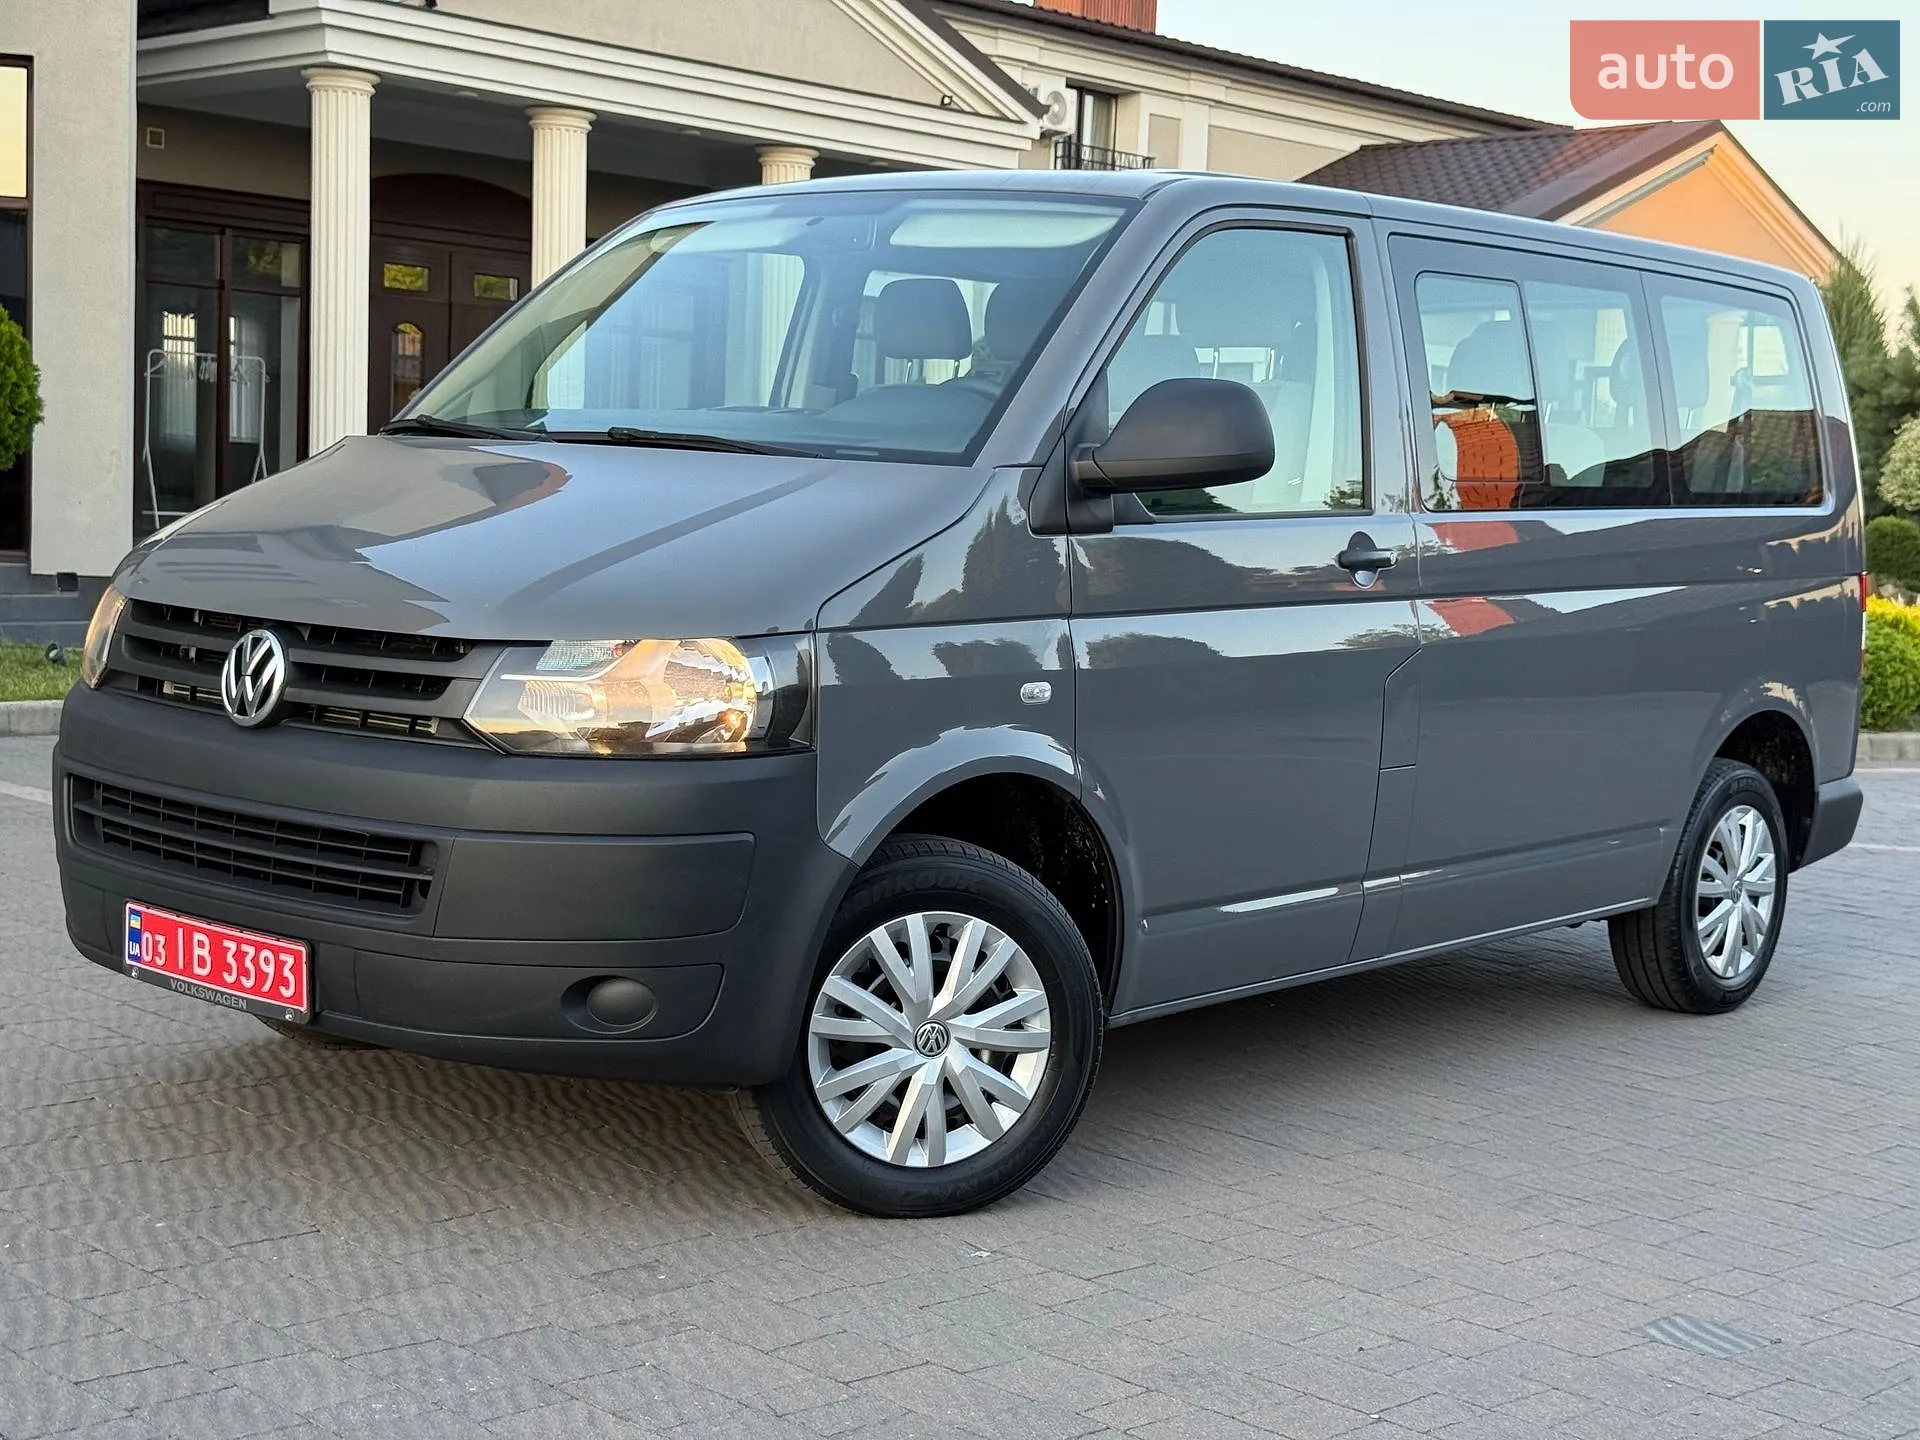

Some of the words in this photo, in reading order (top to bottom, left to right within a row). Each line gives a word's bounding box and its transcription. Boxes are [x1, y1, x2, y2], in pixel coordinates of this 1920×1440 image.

[129, 941, 141, 957] UA
[142, 931, 166, 966] 03
[178, 927, 212, 977] IB
[222, 938, 296, 998] 3393
[170, 978, 247, 1010] VOLKSWAGEN
